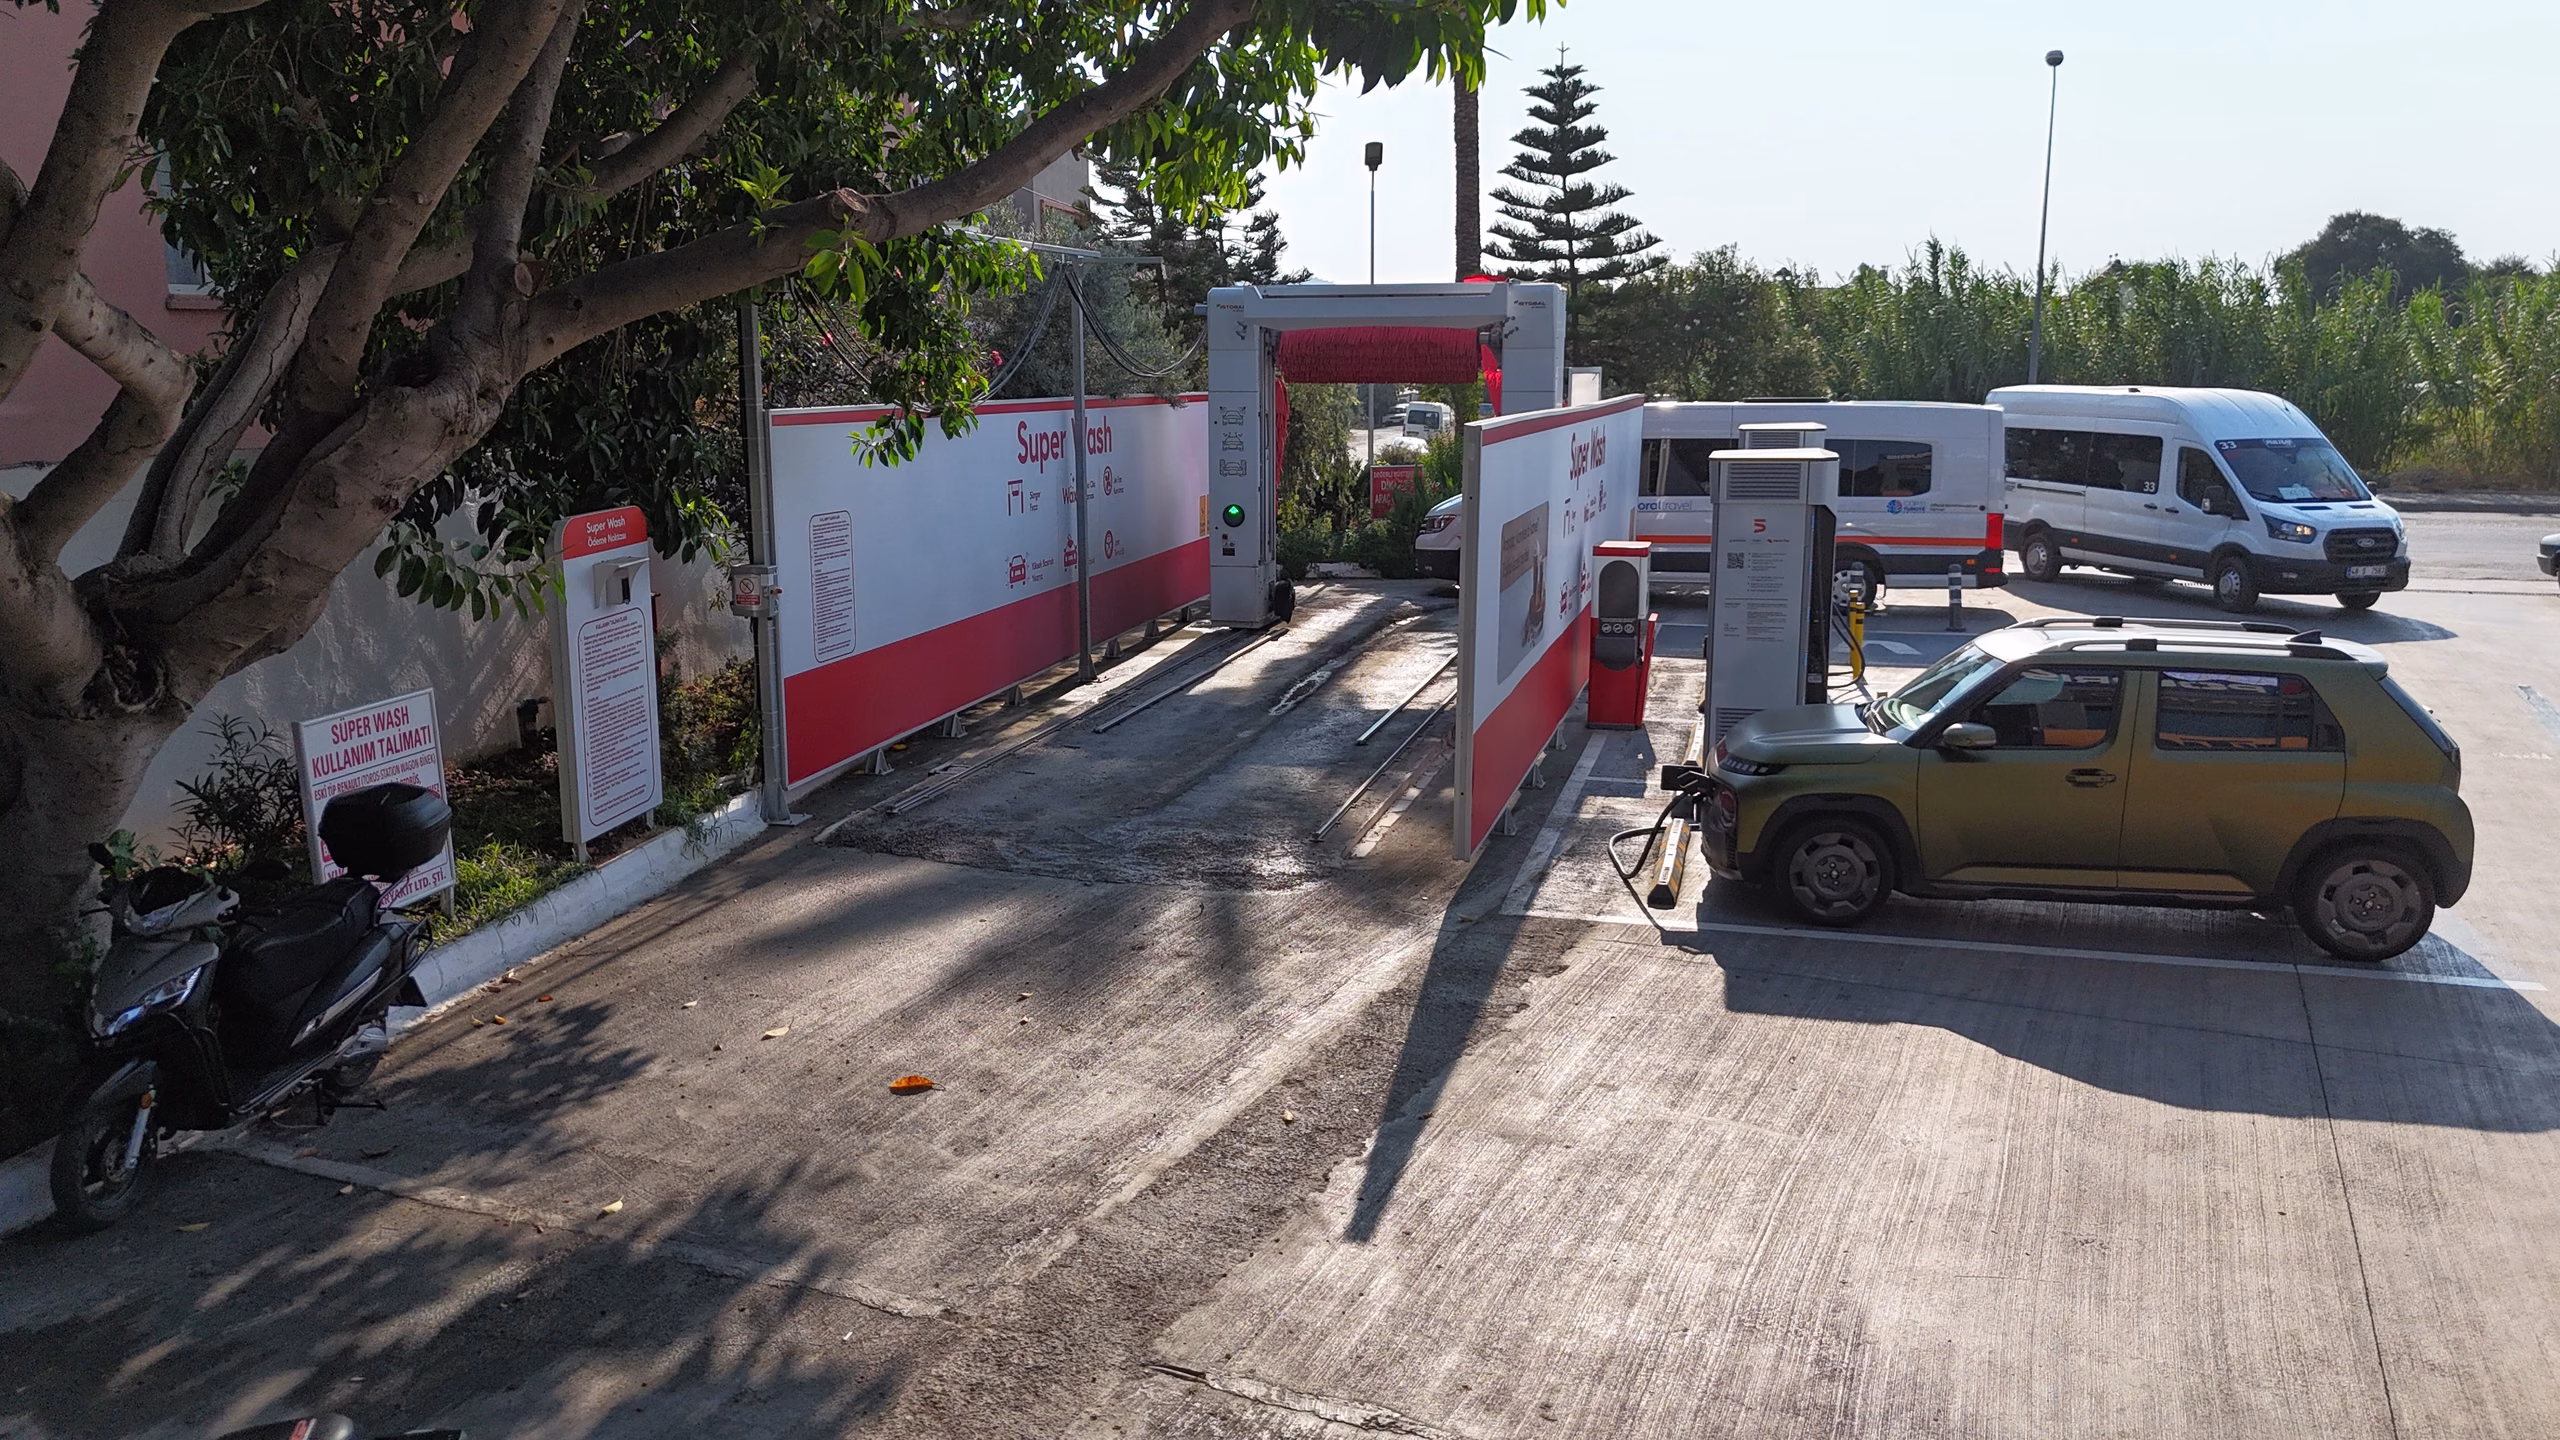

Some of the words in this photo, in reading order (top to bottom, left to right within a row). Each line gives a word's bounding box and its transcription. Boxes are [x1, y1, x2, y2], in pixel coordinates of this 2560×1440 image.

[1018, 420, 1067, 474] Super
[1570, 432, 1589, 491] Super
[1590, 424, 1606, 470] Wash
[2219, 440, 2237, 450] 33
[2143, 481, 2156, 492] 33
[586, 522, 606, 535] Super
[607, 515, 626, 528] Wash
[331, 717, 371, 745] SÜPER
[373, 705, 409, 733] WASH
[312, 741, 377, 778] KULLANIM
[378, 724, 431, 758] TALİMATI
[314, 784, 328, 801] ESKİ
[328, 782, 336, 796] TİP
[336, 777, 361, 794] RENAULT
[380, 884, 413, 906] ARYAKIT
[414, 876, 431, 892] LTD.
[432, 867, 446, 886] ŞTİ.
